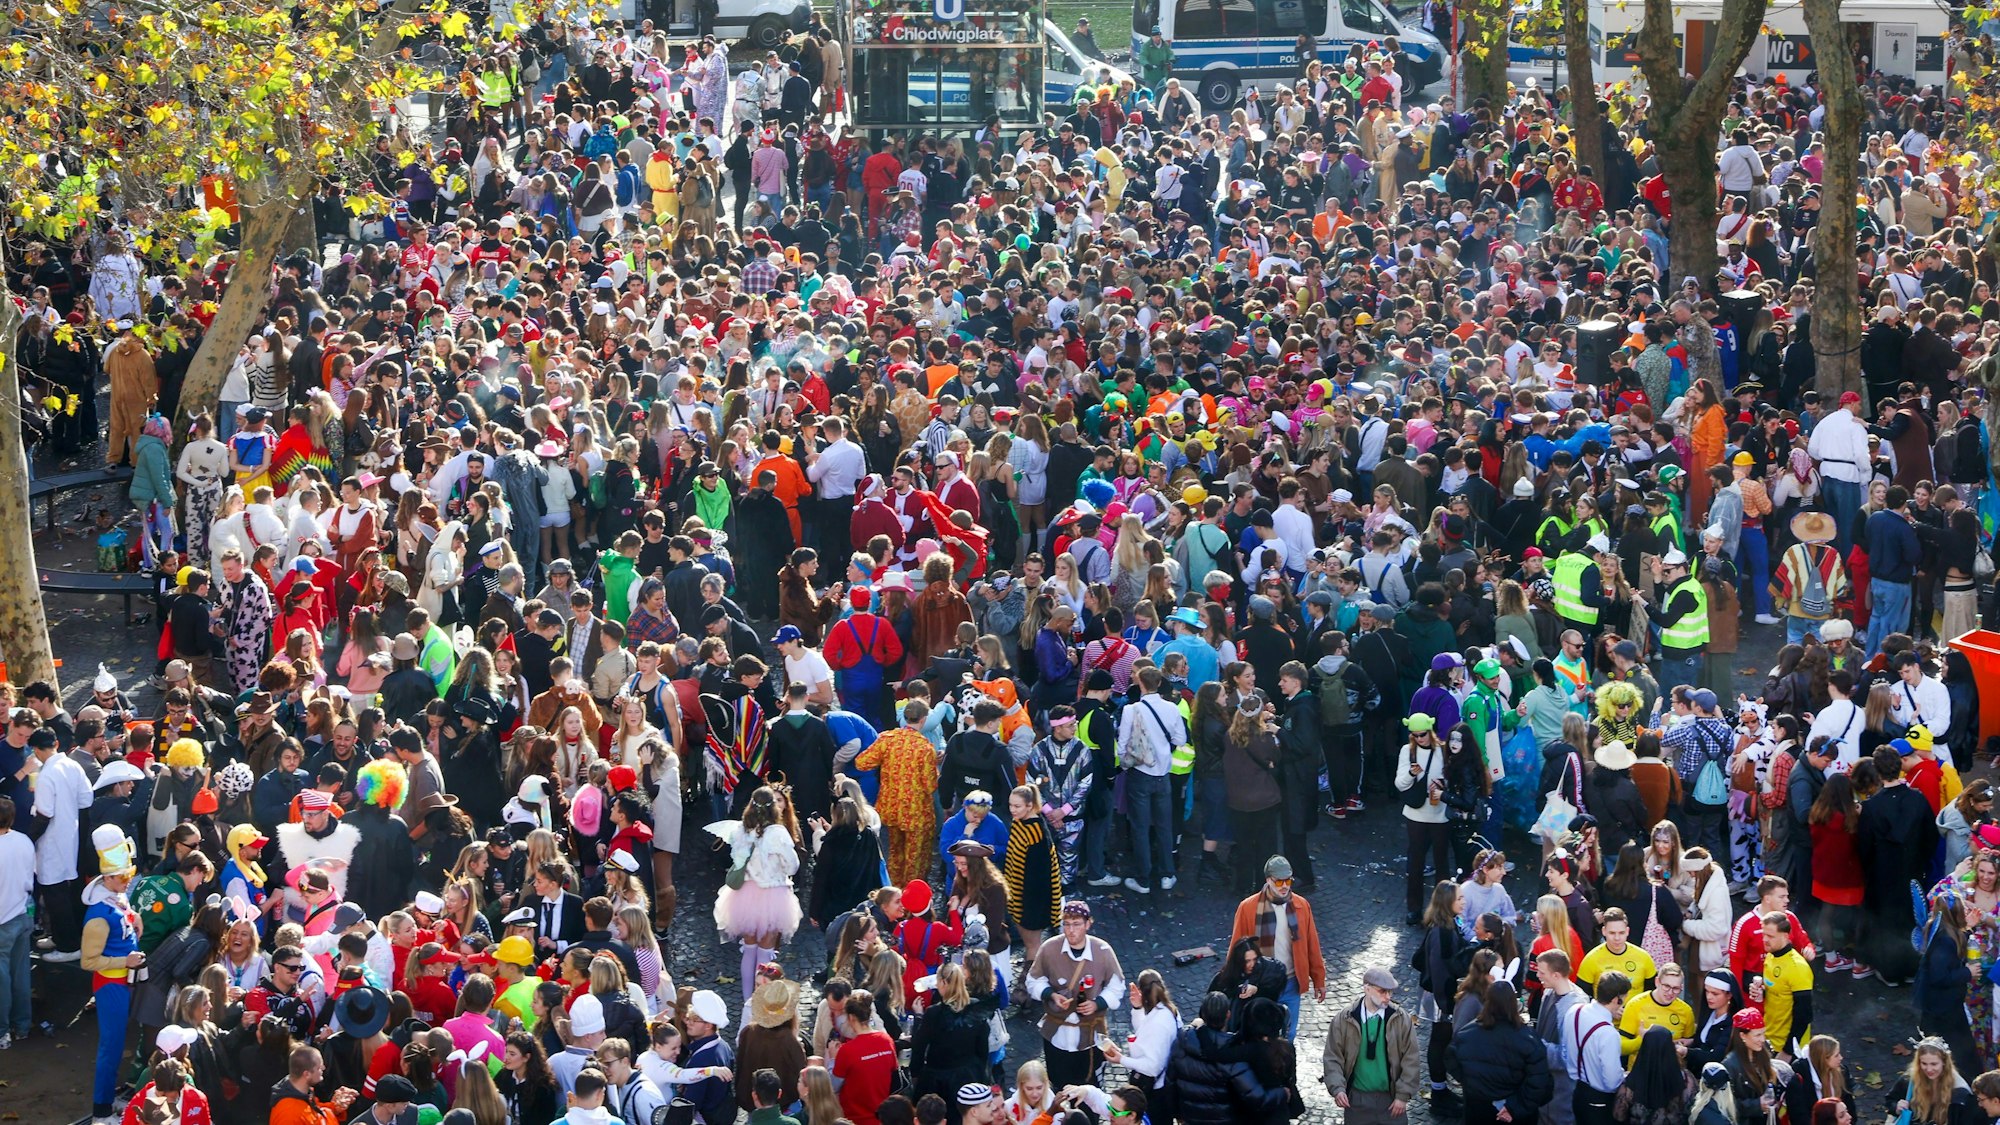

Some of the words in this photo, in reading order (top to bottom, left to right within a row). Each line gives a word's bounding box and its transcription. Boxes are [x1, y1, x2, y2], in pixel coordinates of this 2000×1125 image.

[893, 27, 1003, 43] Chlodwigplatz
[1885, 29, 1908, 37] Damen
[1768, 40, 1794, 64] WC
[1280, 55, 1299, 63] POL
